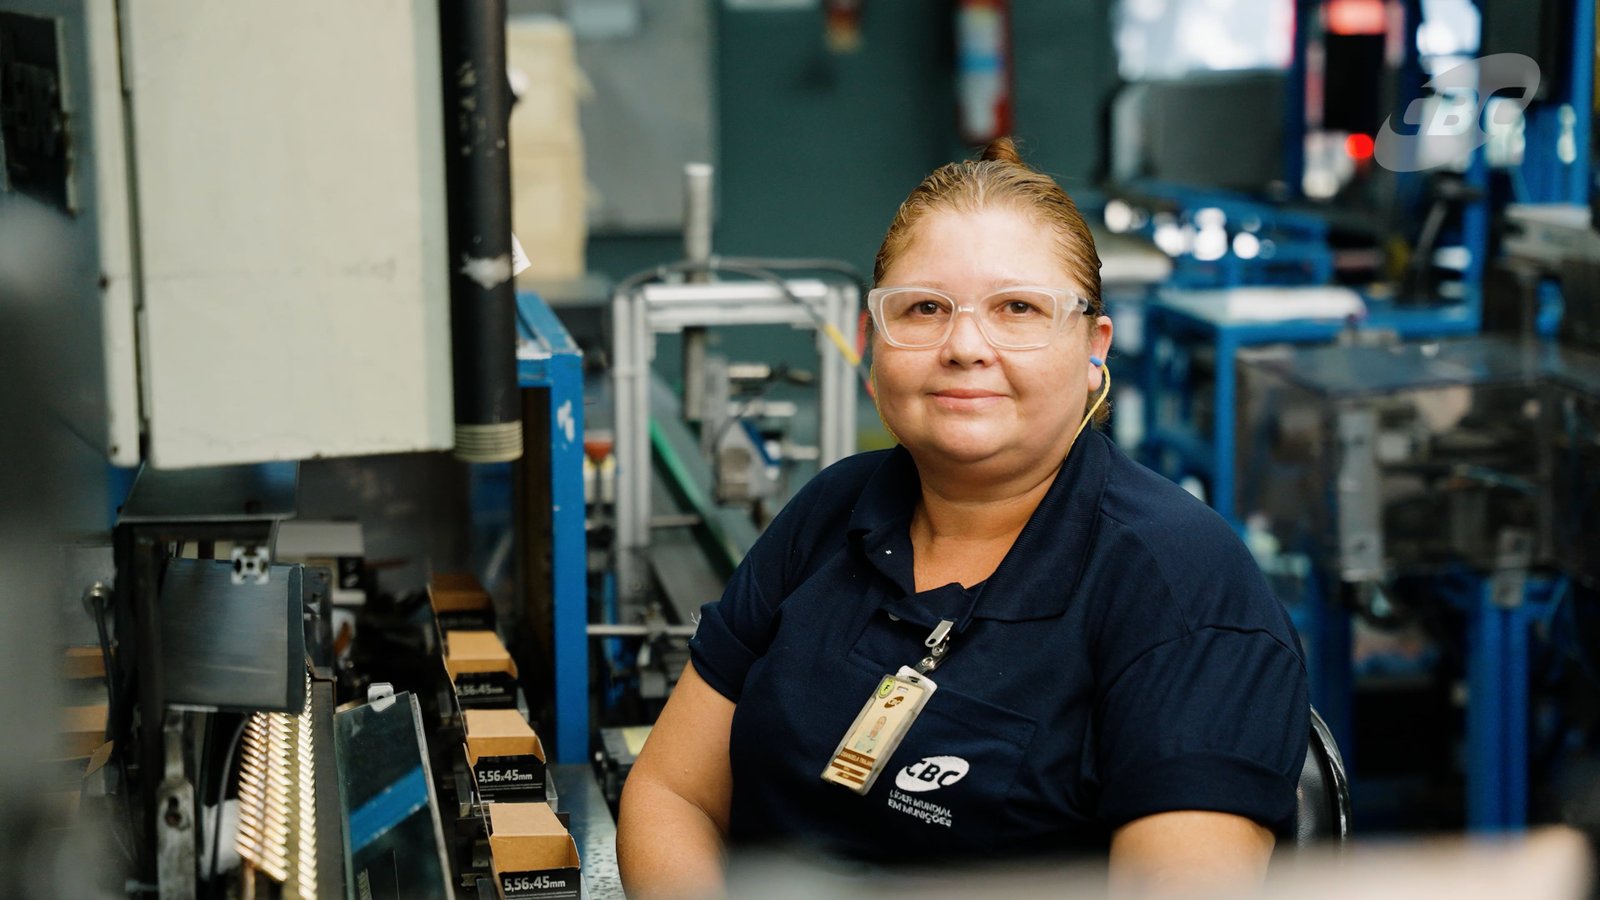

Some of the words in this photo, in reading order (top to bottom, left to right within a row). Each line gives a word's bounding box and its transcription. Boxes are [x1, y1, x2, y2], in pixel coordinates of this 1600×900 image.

[478, 769, 533, 784] 5,56x45mm
[905, 761, 961, 788] CBC
[888, 798, 902, 811] EM
[504, 875, 566, 893] 5,56x45mm
